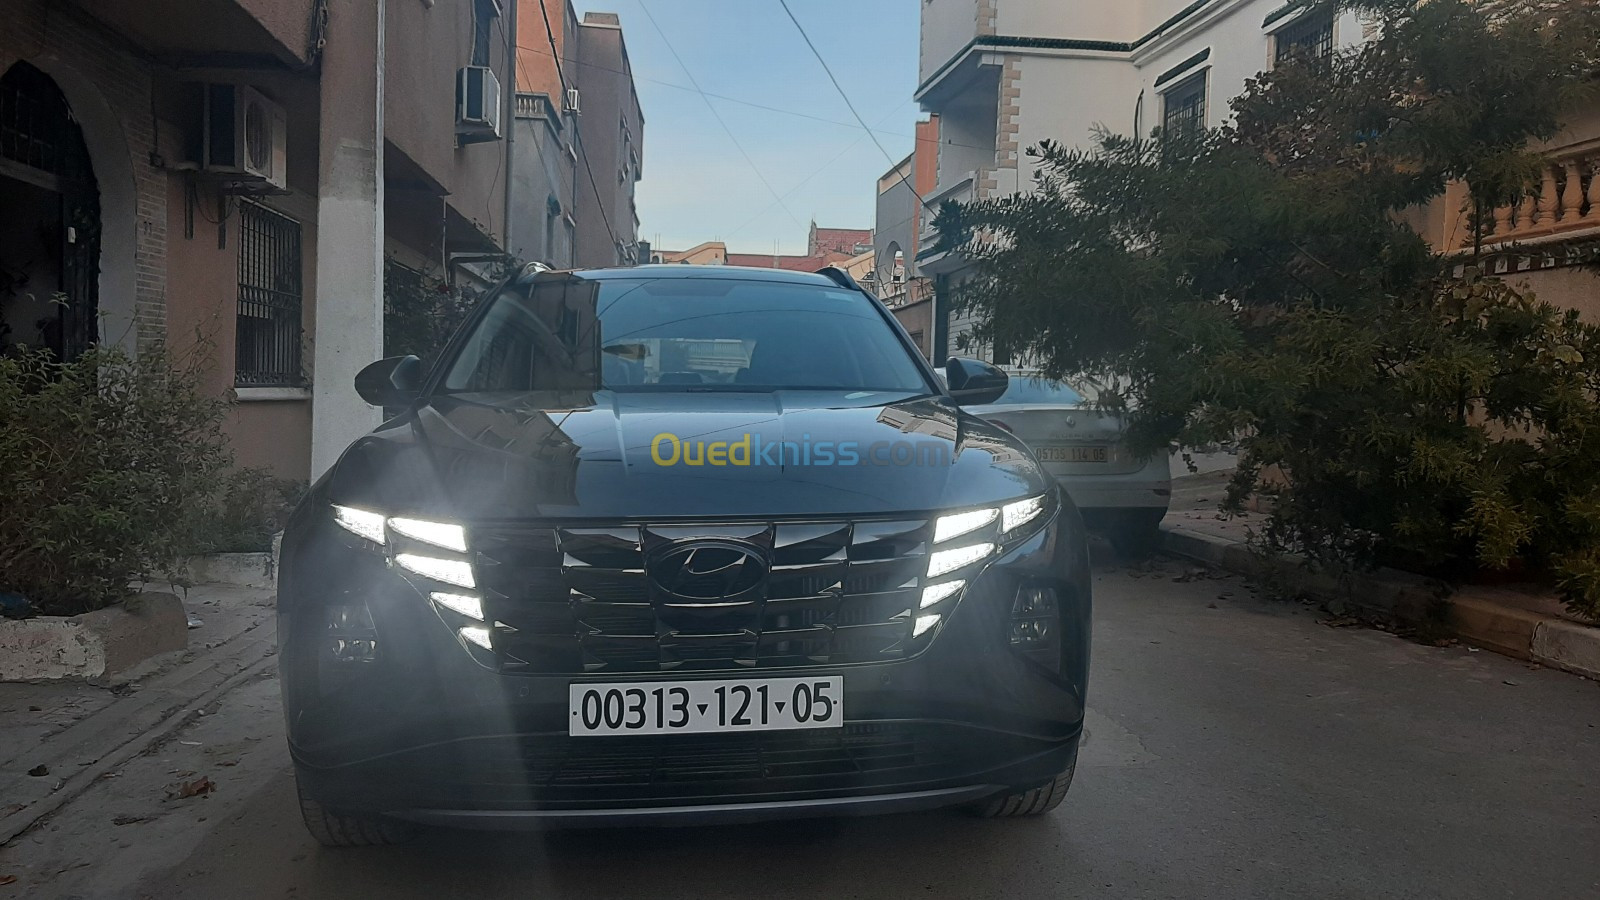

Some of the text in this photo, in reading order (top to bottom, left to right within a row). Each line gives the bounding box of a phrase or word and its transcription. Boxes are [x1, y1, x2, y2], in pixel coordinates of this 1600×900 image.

[1071, 447, 1089, 460] 114
[1093, 447, 1105, 460] 05
[582, 681, 833, 730] 00313 121 05
